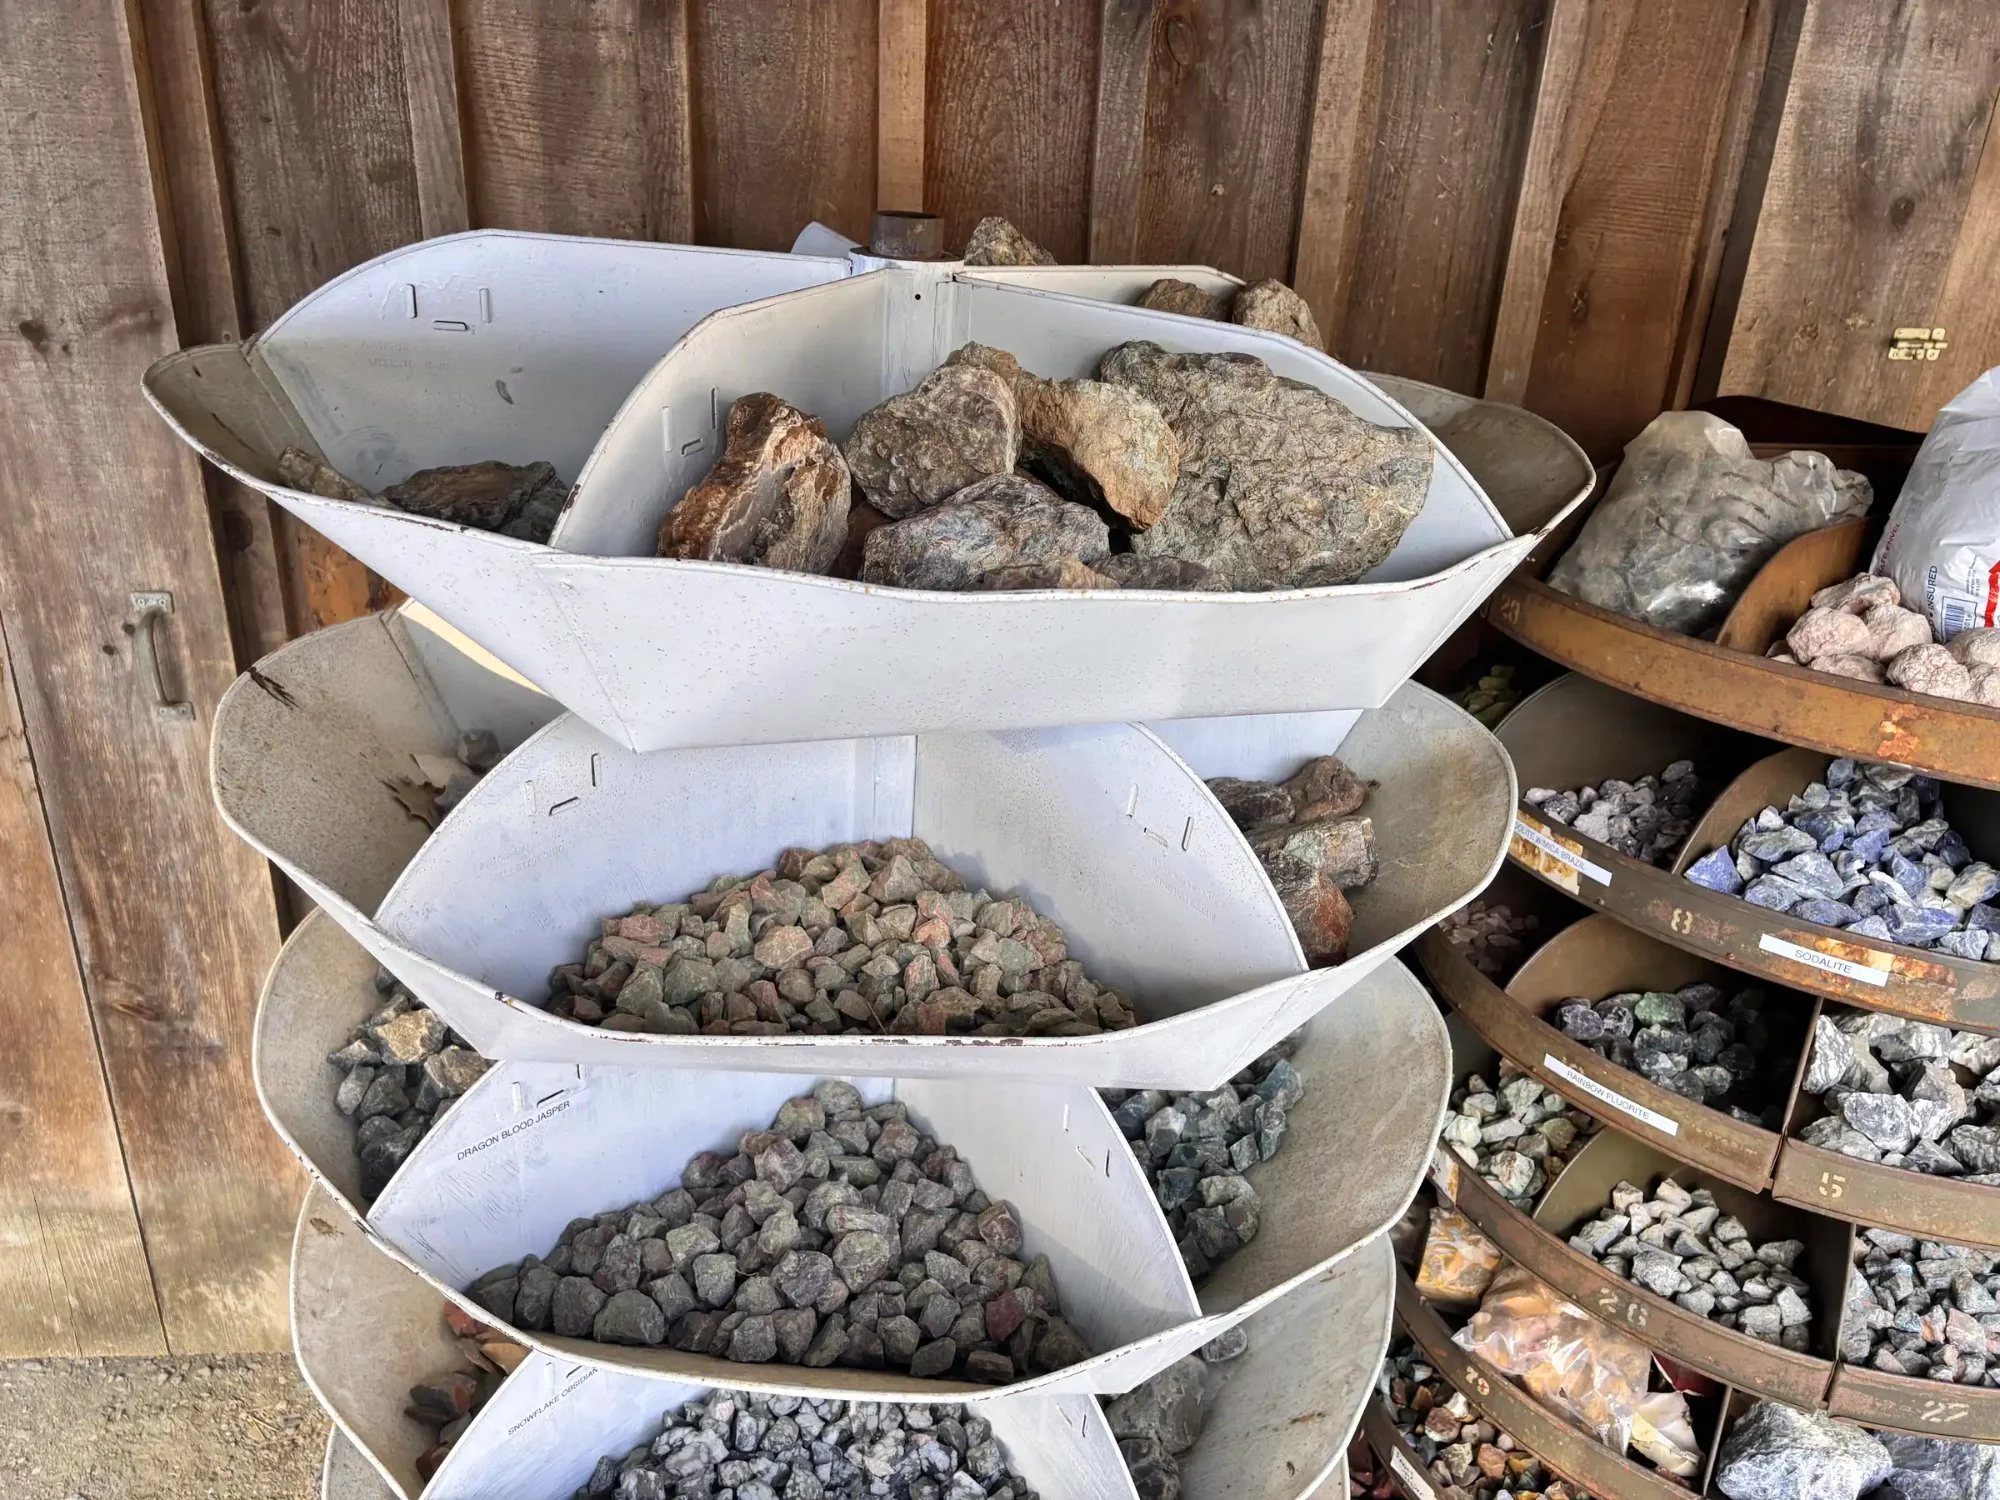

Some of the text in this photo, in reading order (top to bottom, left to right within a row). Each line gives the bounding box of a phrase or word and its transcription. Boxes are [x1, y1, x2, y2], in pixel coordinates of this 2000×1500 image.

[1926, 565, 1938, 610] INSURED
[1560, 851, 1586, 871] BRAZIL
[1671, 908, 1693, 934] 8
[1794, 949, 1853, 974] SODALITE
[1567, 1070, 1650, 1120] RAINBOW FLUORITE
[457, 1100, 570, 1161] DRAGON BLOOD JASPER
[1819, 1171, 1846, 1198] 5
[1598, 1287, 1648, 1327] 26
[507, 1366, 599, 1436] SNOWFLAKE OBSIDIAN
[1920, 1400, 1970, 1422] 27
